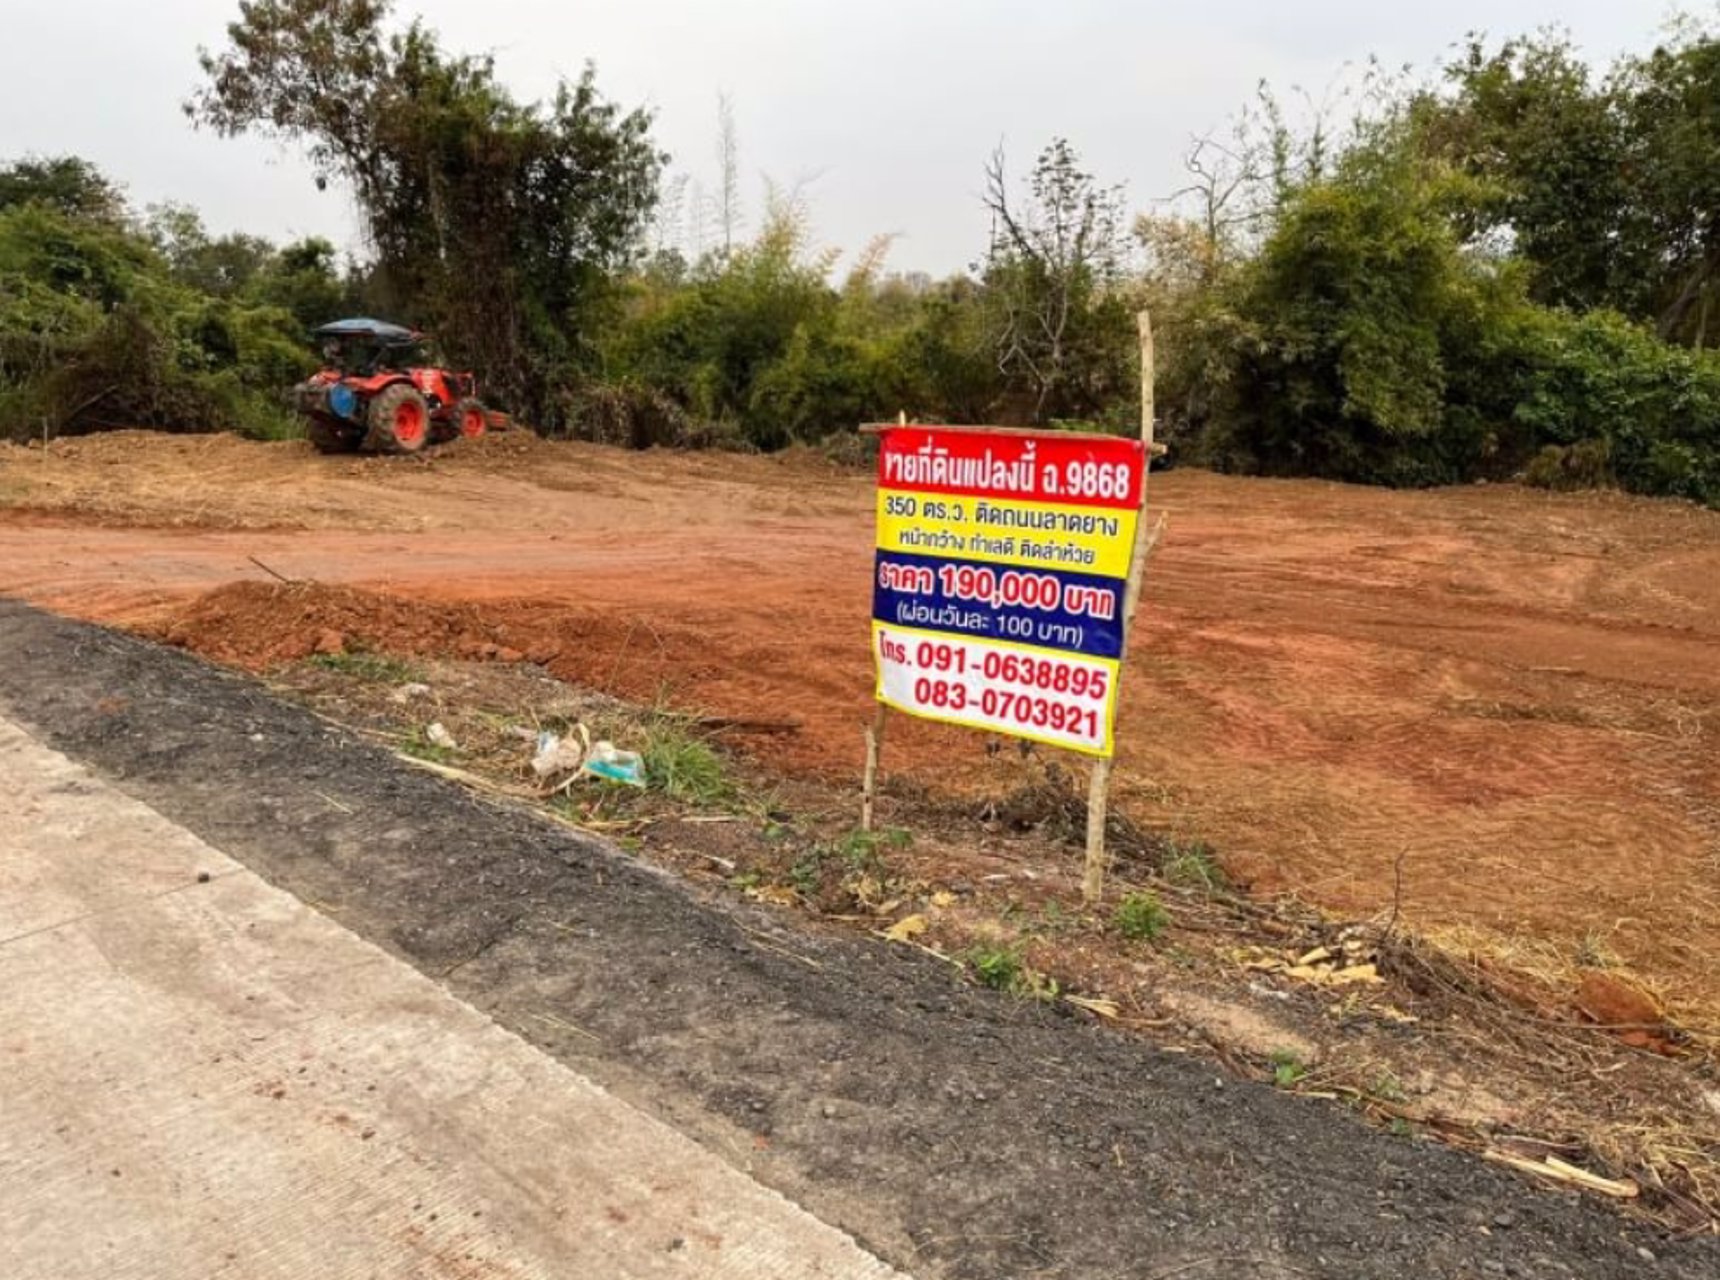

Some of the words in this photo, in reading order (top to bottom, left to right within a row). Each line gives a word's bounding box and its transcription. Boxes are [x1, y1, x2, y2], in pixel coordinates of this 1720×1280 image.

[884, 496, 915, 516] 350
[923, 501, 969, 521] ตร.ว.
[975, 503, 1118, 536] ติดถนนลาดยาง
[898, 526, 966, 552] หน้ากว้าง
[969, 533, 1013, 556] ทำเลดี
[1019, 541, 1095, 565] ติดลำห้วย
[879, 562, 935, 593] ราคา
[938, 565, 1060, 608] 190,000
[1063, 585, 1115, 621] บาท
[896, 598, 989, 631] (ผ่อนวันละ
[996, 615, 1034, 638] 100
[1037, 625, 1084, 648] บาท)
[917, 641, 1106, 700] 091-0638895
[914, 677, 1098, 738] 083-0703921
